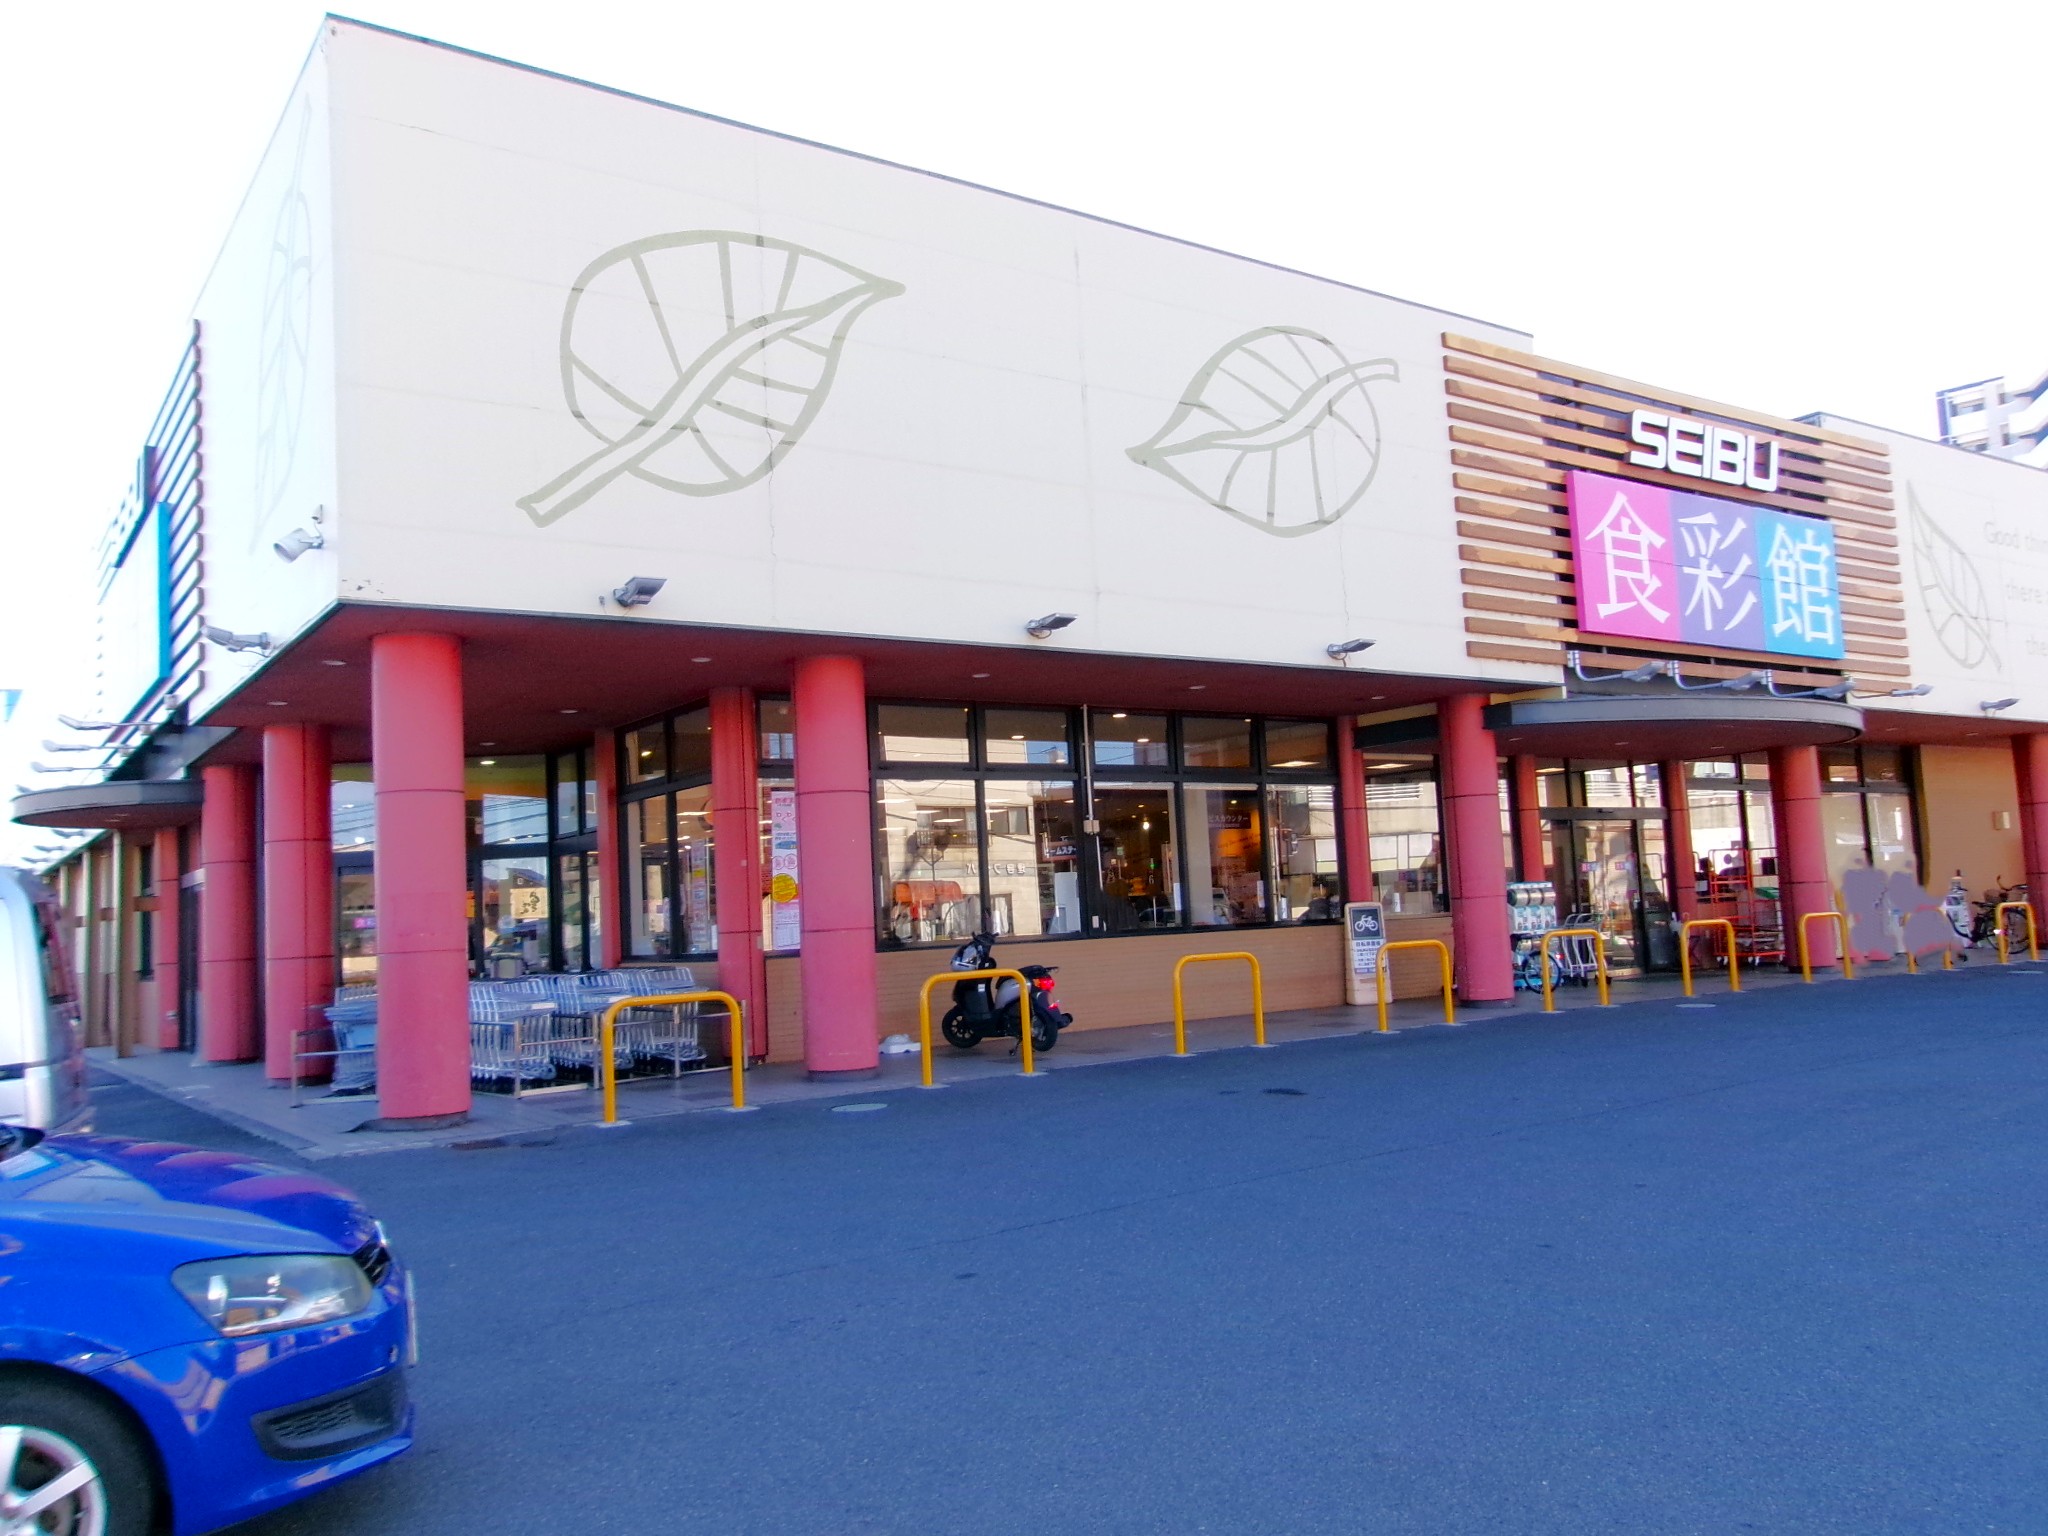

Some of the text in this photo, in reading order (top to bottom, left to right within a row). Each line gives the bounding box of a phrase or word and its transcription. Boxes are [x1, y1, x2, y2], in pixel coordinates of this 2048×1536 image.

[1630, 408, 1779, 492] SEIBU
[1984, 520, 2020, 549] Good
[1585, 490, 1835, 646] 食彩館
[2005, 578, 2043, 605] there
